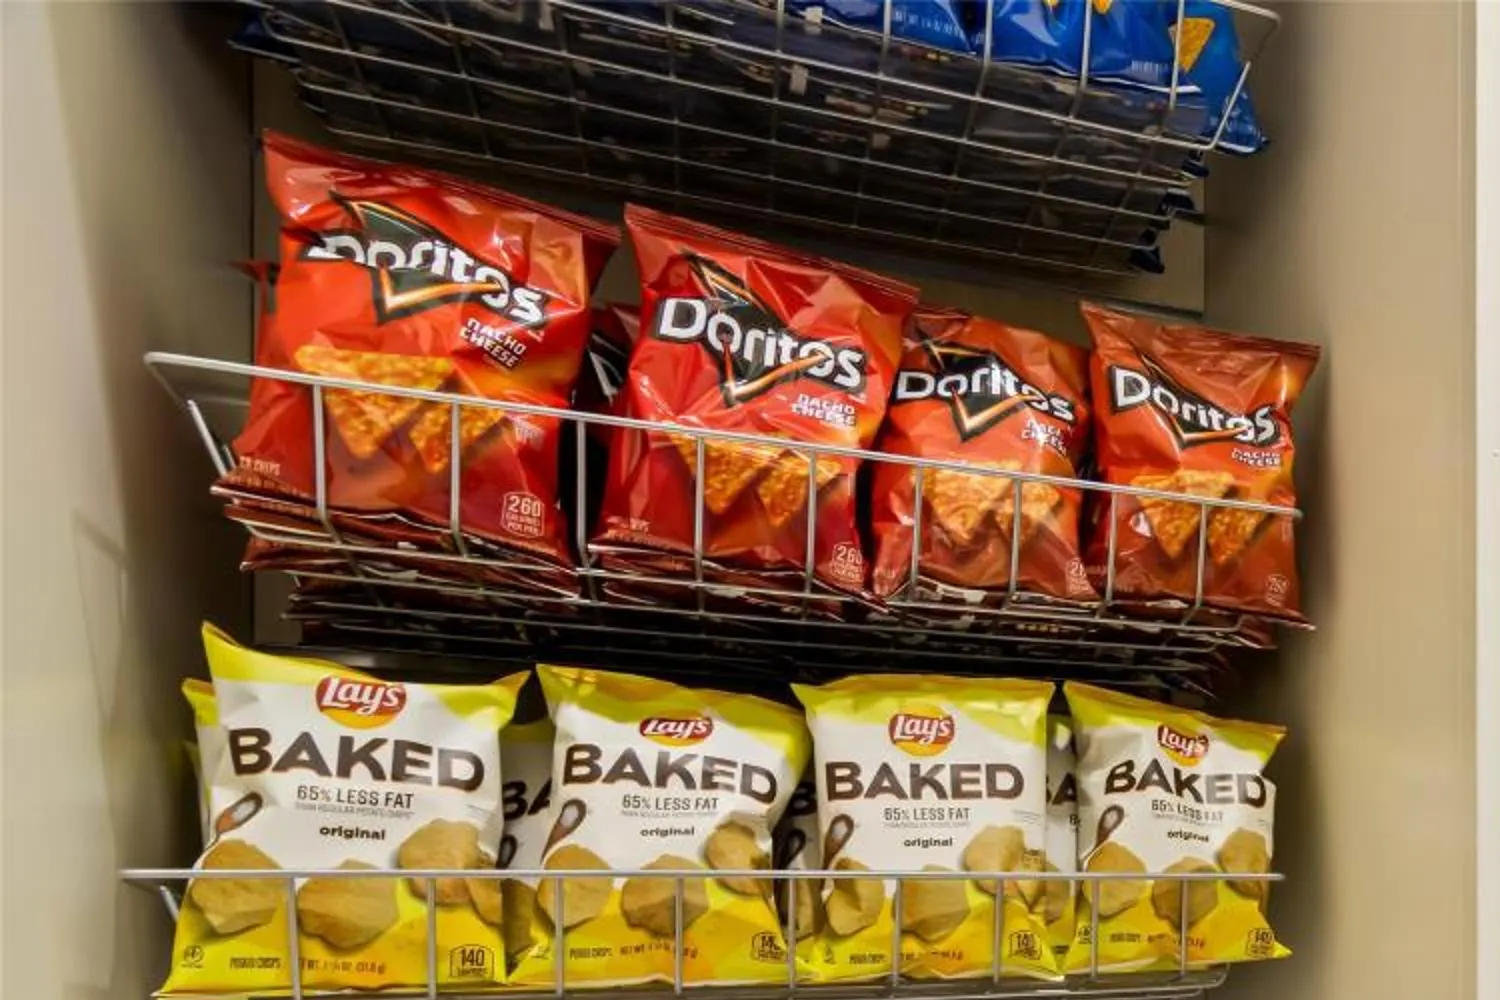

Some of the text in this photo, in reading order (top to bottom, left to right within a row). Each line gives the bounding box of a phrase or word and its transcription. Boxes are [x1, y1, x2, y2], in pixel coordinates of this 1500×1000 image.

[308, 233, 547, 327] Doritos
[459, 326, 519, 367] CHEESE
[658, 298, 867, 388] Doritos
[898, 364, 1075, 421] Doritos
[1115, 367, 1276, 442] Doritos
[508, 495, 541, 517] 260
[320, 676, 403, 716] Lay's
[894, 715, 953, 744] Lay's
[229, 727, 486, 793] BAKED
[562, 743, 778, 804] BAKED
[297, 784, 332, 802] 65%
[336, 787, 380, 807] LESS
[384, 791, 415, 810] FAT
[825, 761, 1025, 801] BAKED
[1104, 758, 1268, 809] BAKED
[655, 797, 690, 811] LESS
[694, 797, 719, 811] FAT
[914, 806, 945, 821] LESS
[948, 806, 971, 821] FAT
[319, 825, 387, 841] original
[640, 825, 695, 838] original
[903, 836, 953, 848] original
[461, 948, 485, 967] 140
